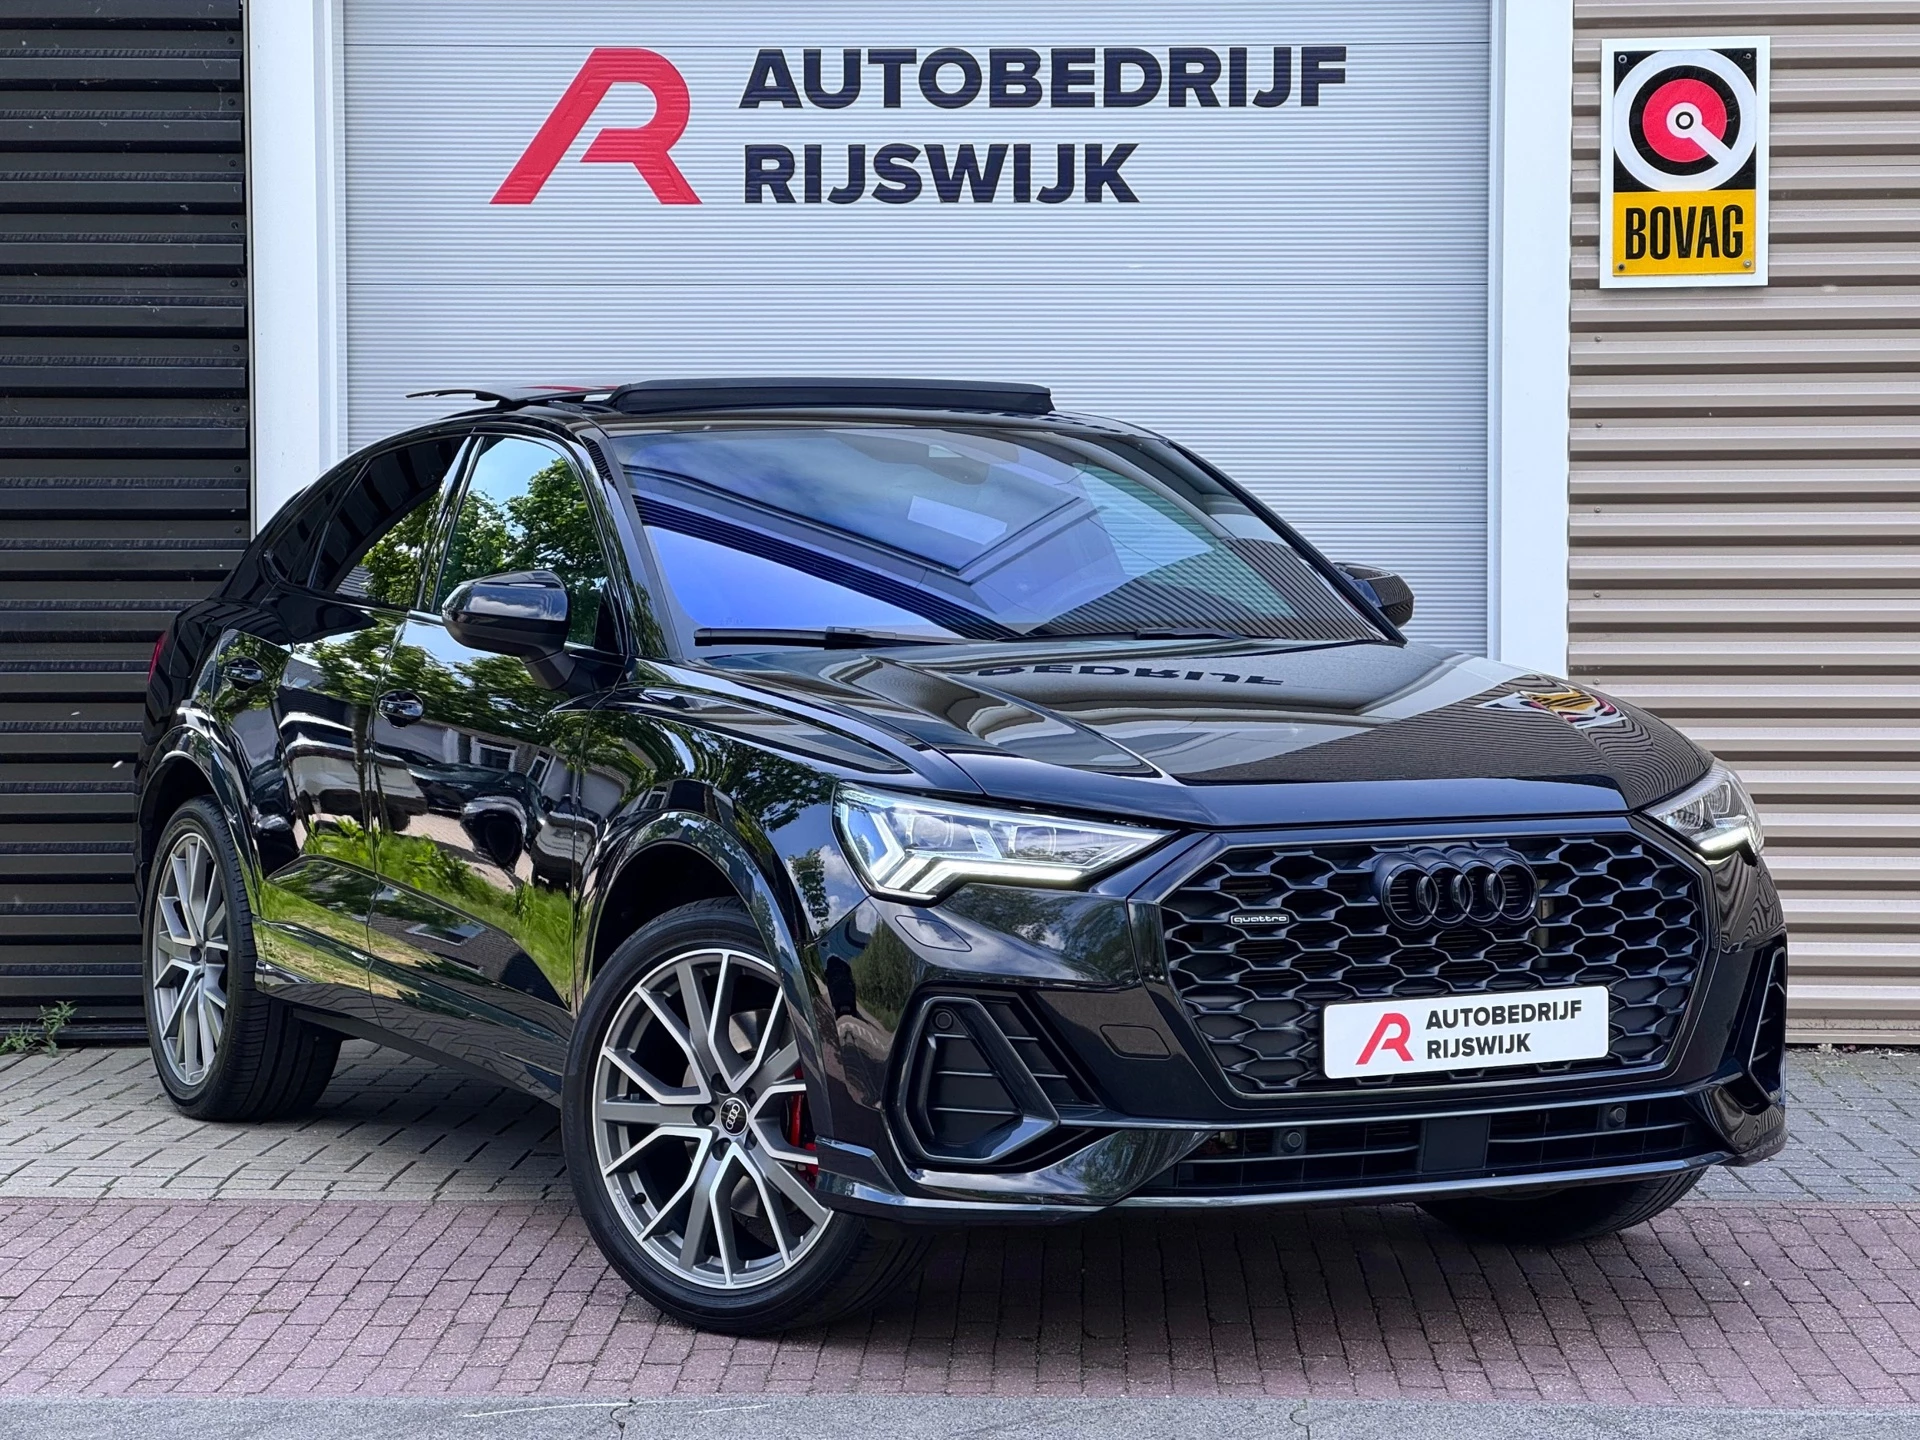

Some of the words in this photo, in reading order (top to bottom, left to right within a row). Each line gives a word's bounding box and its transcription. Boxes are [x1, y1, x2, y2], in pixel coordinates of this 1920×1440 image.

[738, 46, 1347, 109] AUTOBEDRIJF
[744, 143, 1140, 204] RIJSWIJK
[1625, 204, 1744, 260] BOVAG
[1233, 915, 1287, 924] quattro
[1425, 1000, 1582, 1030] AUTOBEDRIJF
[1427, 1033, 1531, 1060] RIJSWIJK
